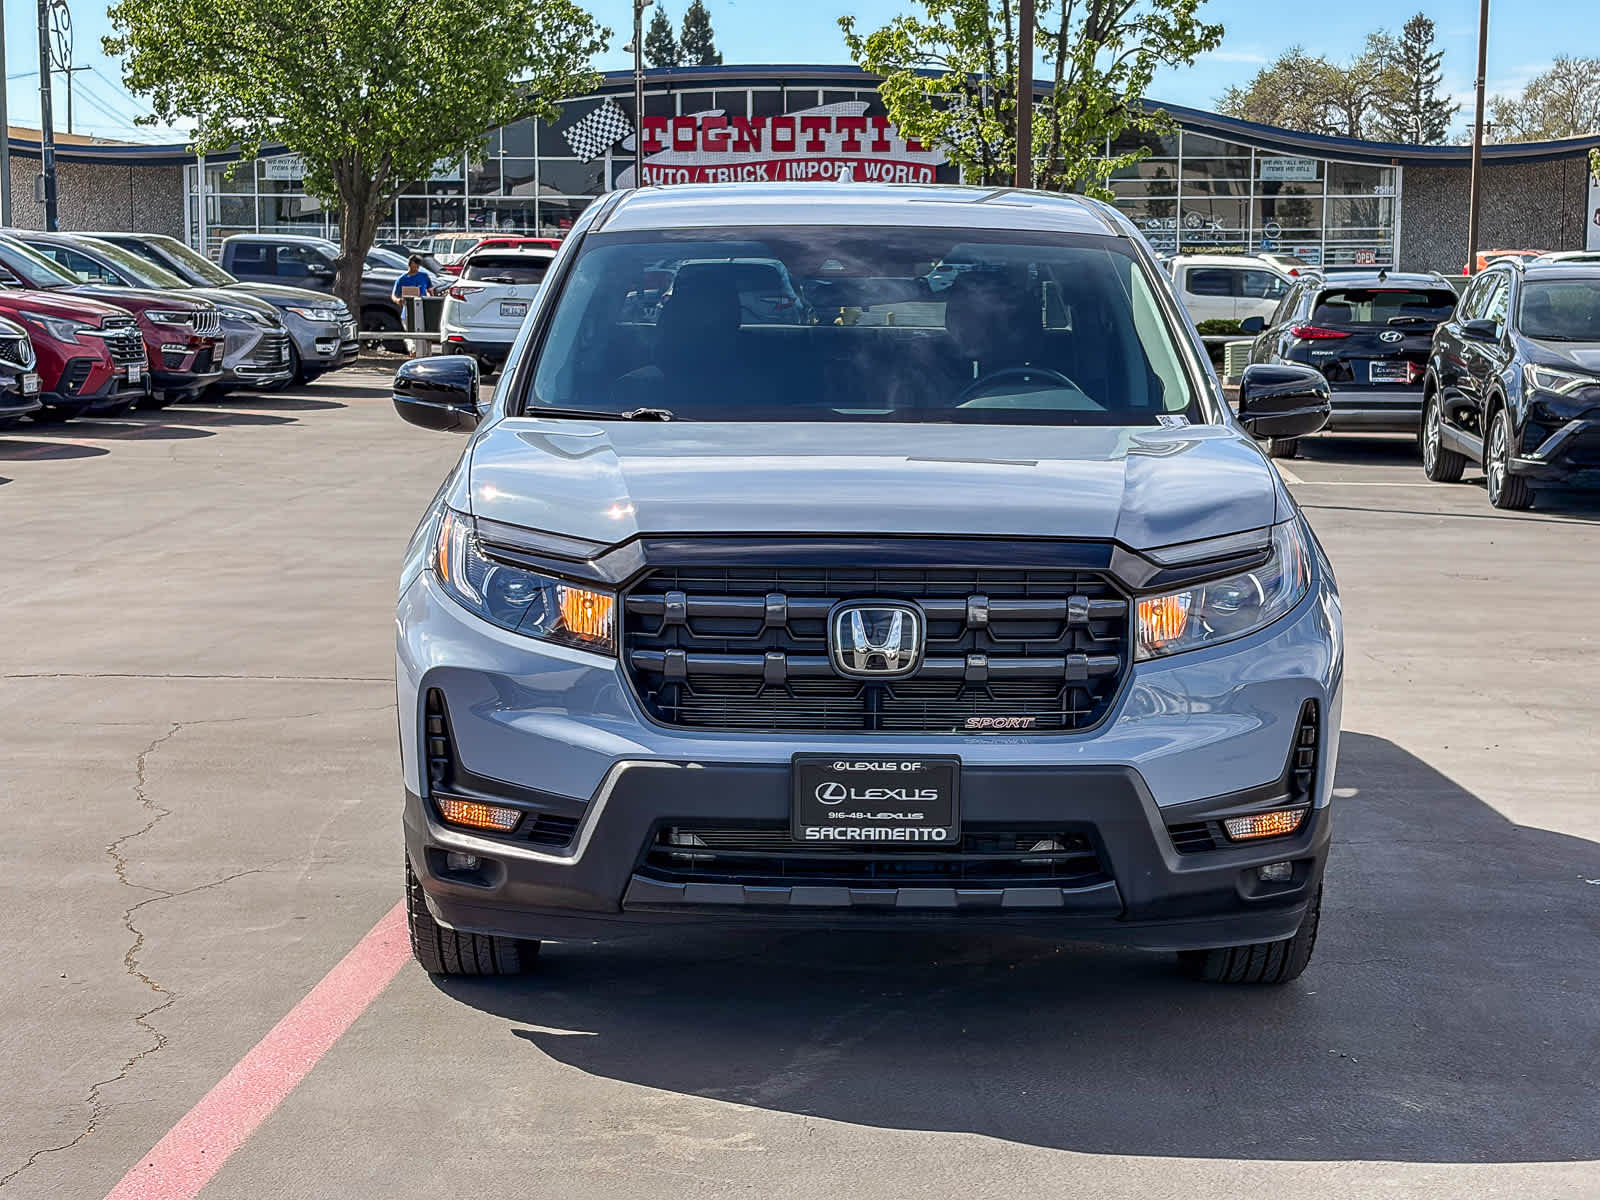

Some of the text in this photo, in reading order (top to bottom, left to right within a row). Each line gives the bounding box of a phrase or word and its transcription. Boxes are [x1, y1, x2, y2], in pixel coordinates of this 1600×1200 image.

[641, 166, 690, 185] AUTO
[704, 164, 770, 183] TRUCK
[785, 161, 859, 181] IMPORT
[864, 162, 932, 185] WORLD
[1355, 251, 1376, 265] OPEN
[964, 717, 1037, 729] SPORT
[846, 762, 921, 771] LEXUS OF
[850, 788, 938, 800] LEXUS
[828, 811, 924, 820] 916-48-LEXUS
[805, 827, 947, 841] SACRAMENTO
